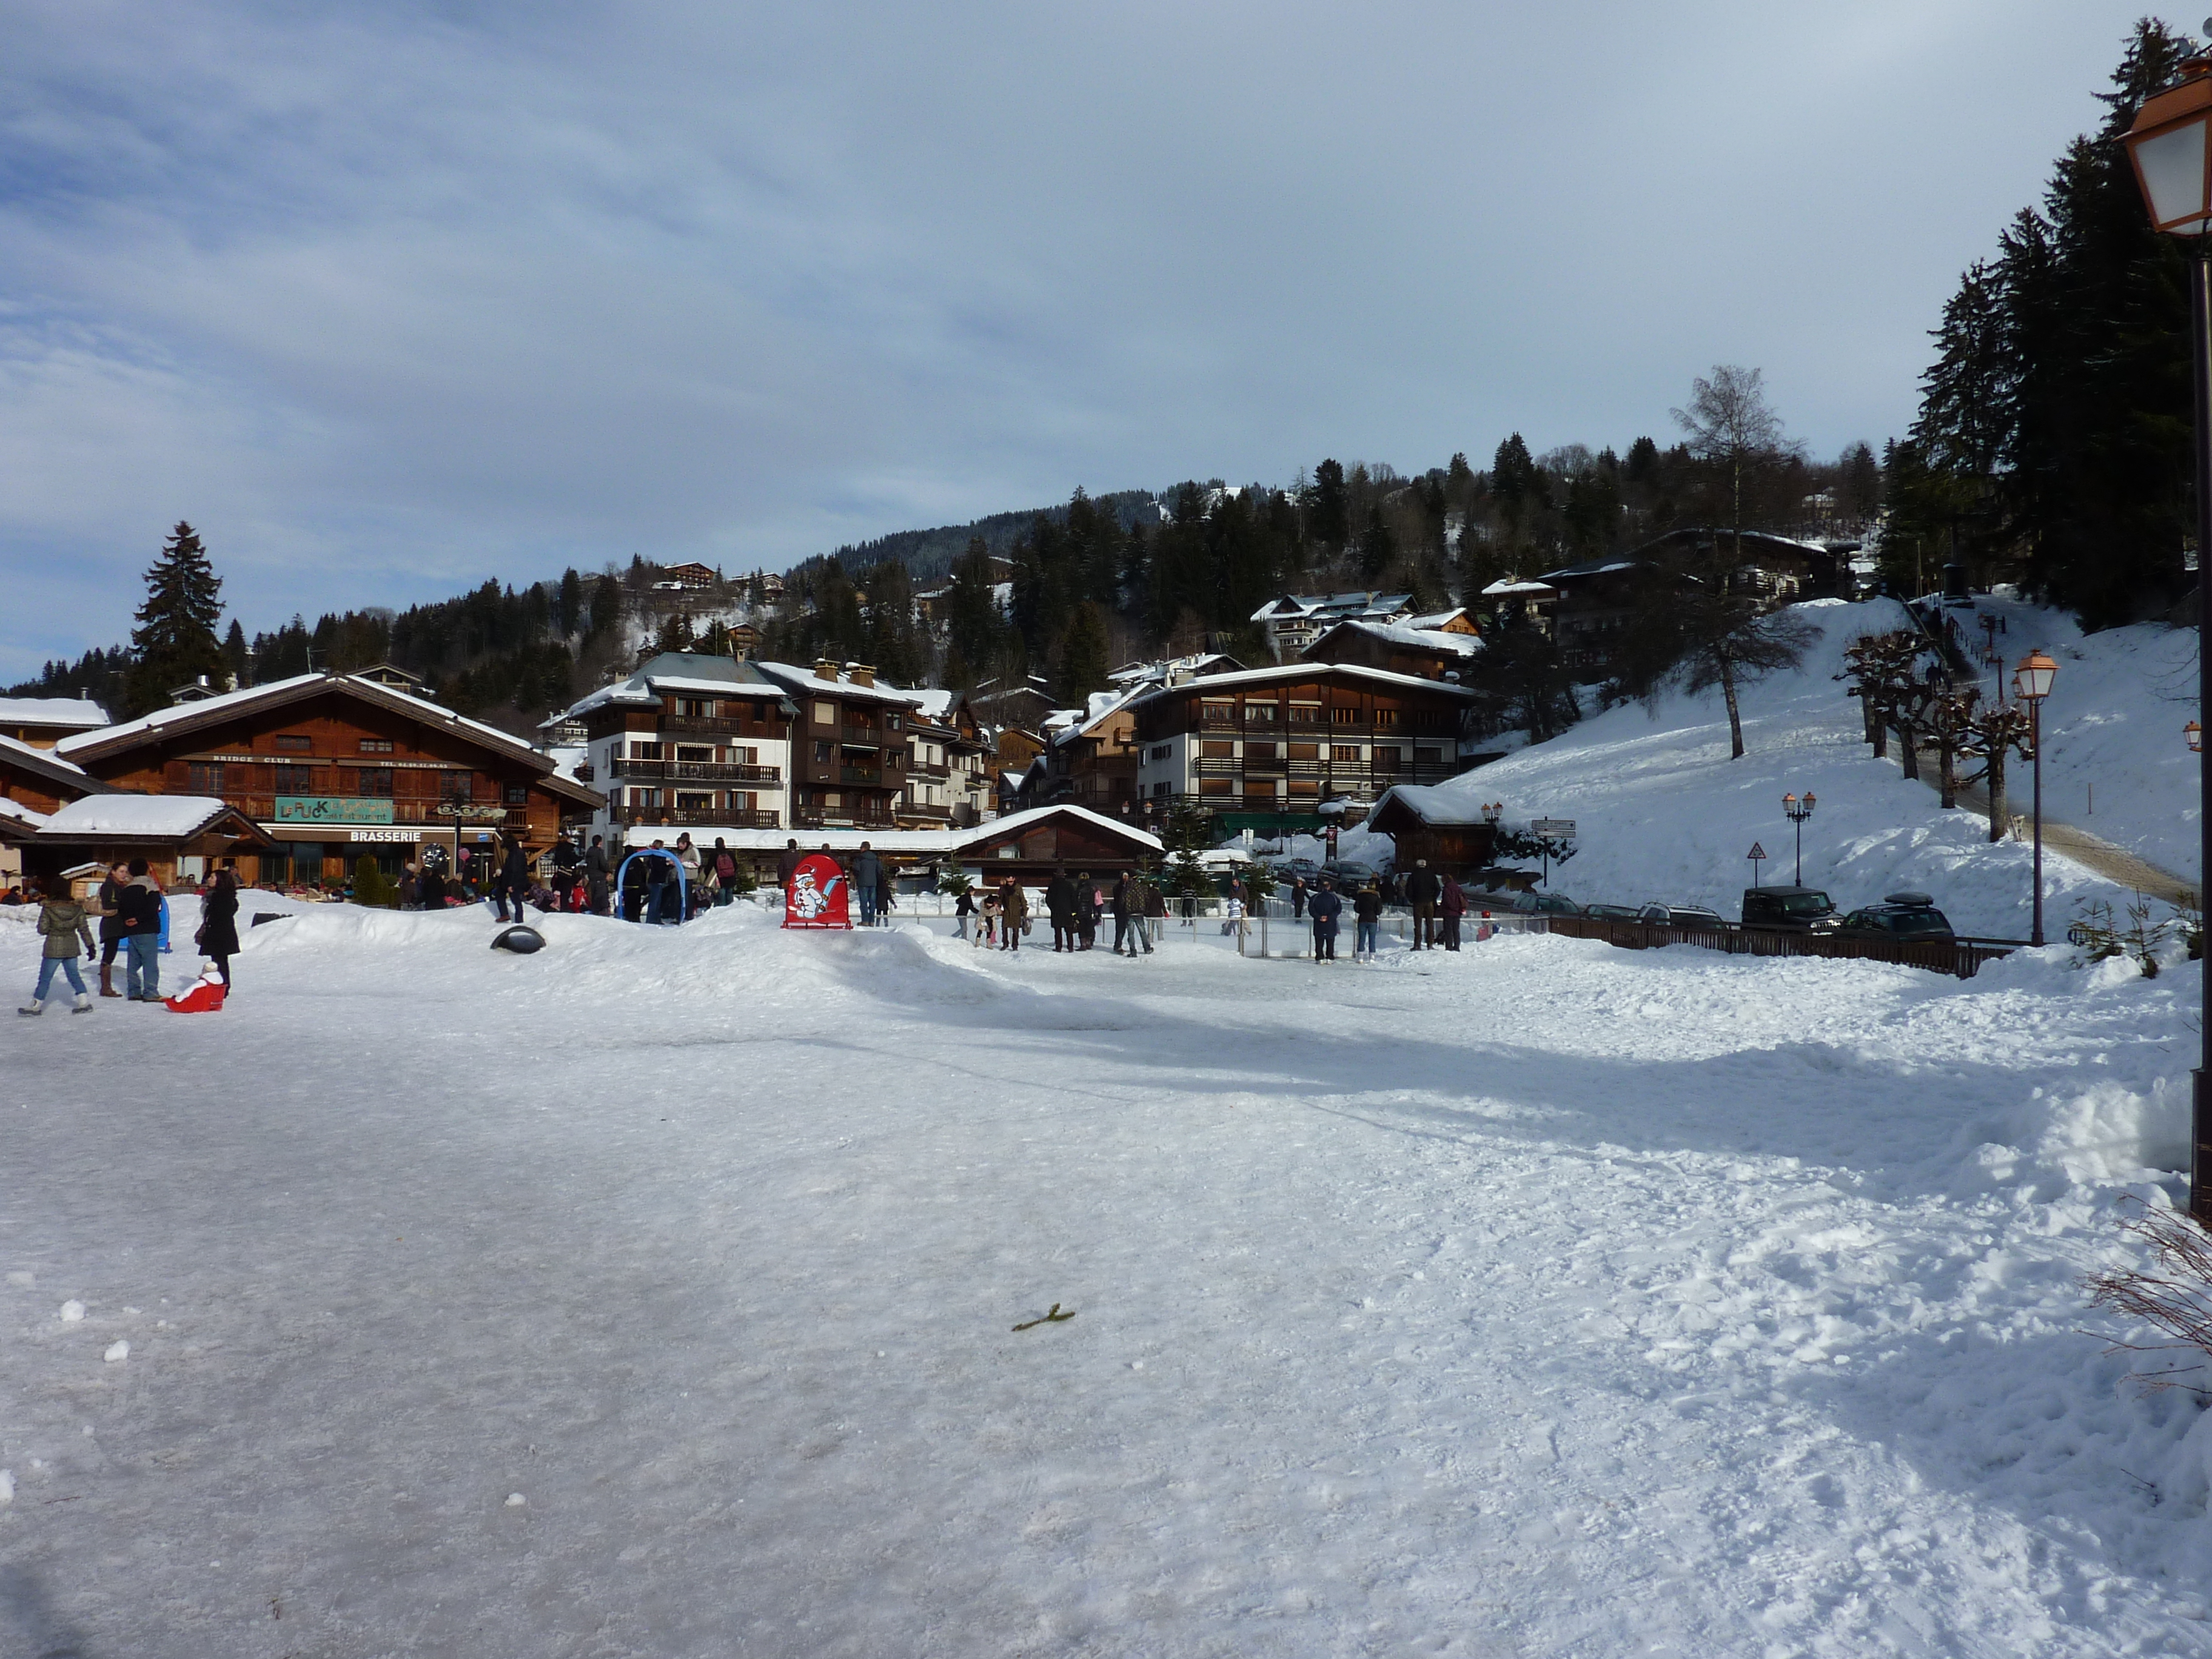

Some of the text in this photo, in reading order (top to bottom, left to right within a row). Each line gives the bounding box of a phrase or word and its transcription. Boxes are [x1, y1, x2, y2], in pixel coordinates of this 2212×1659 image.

[280, 800, 328, 819] LE PUCK
[339, 812, 387, 822] restaurant
[350, 831, 421, 842] BRASSERIE
